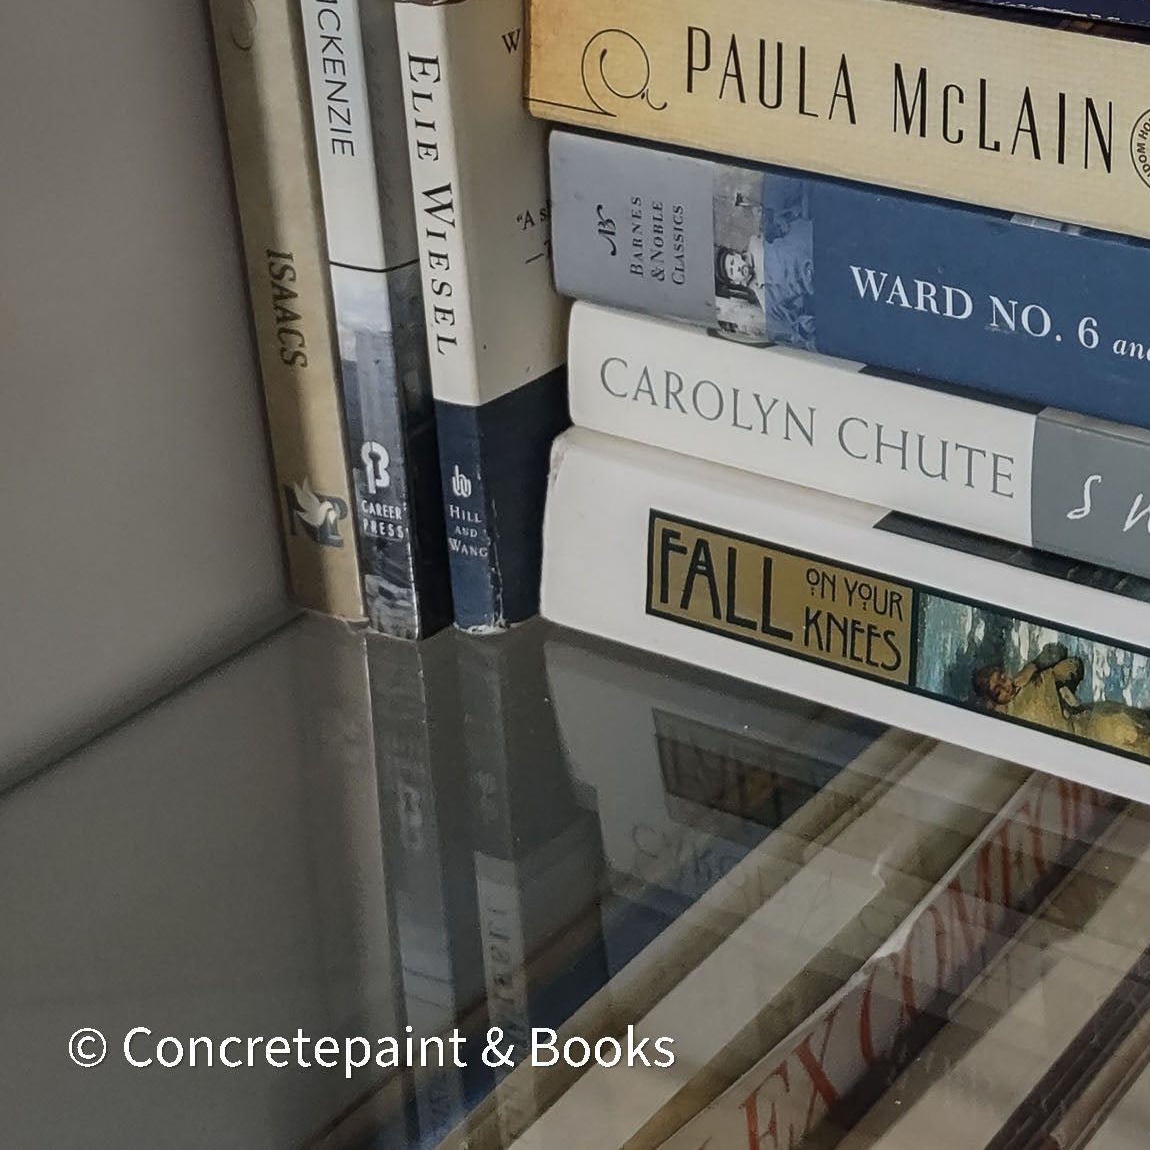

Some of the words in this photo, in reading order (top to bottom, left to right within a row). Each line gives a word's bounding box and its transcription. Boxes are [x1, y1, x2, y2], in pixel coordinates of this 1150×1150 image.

[407, 51, 441, 163] ELIE
[687, 25, 857, 125] PAULA
[421, 182, 460, 356] WIESEL
[630, 196, 645, 277] BARNES
[671, 205, 686, 285] CLASSICS
[265, 248, 308, 369] ISAACS
[850, 265, 974, 321] WARD
[989, 294, 1063, 344] NO.
[1076, 316, 1100, 350] 6
[600, 356, 816, 445] CAROLYN
[838, 416, 1015, 498] CHUTE
[362, 500, 402, 520] CAREER
[362, 519, 404, 539] PRESS
[449, 538, 489, 558] WANG
[659, 527, 793, 640] FALL
[806, 567, 836, 602] ON
[845, 576, 903, 621] YOUR
[803, 606, 901, 672] KNEES
